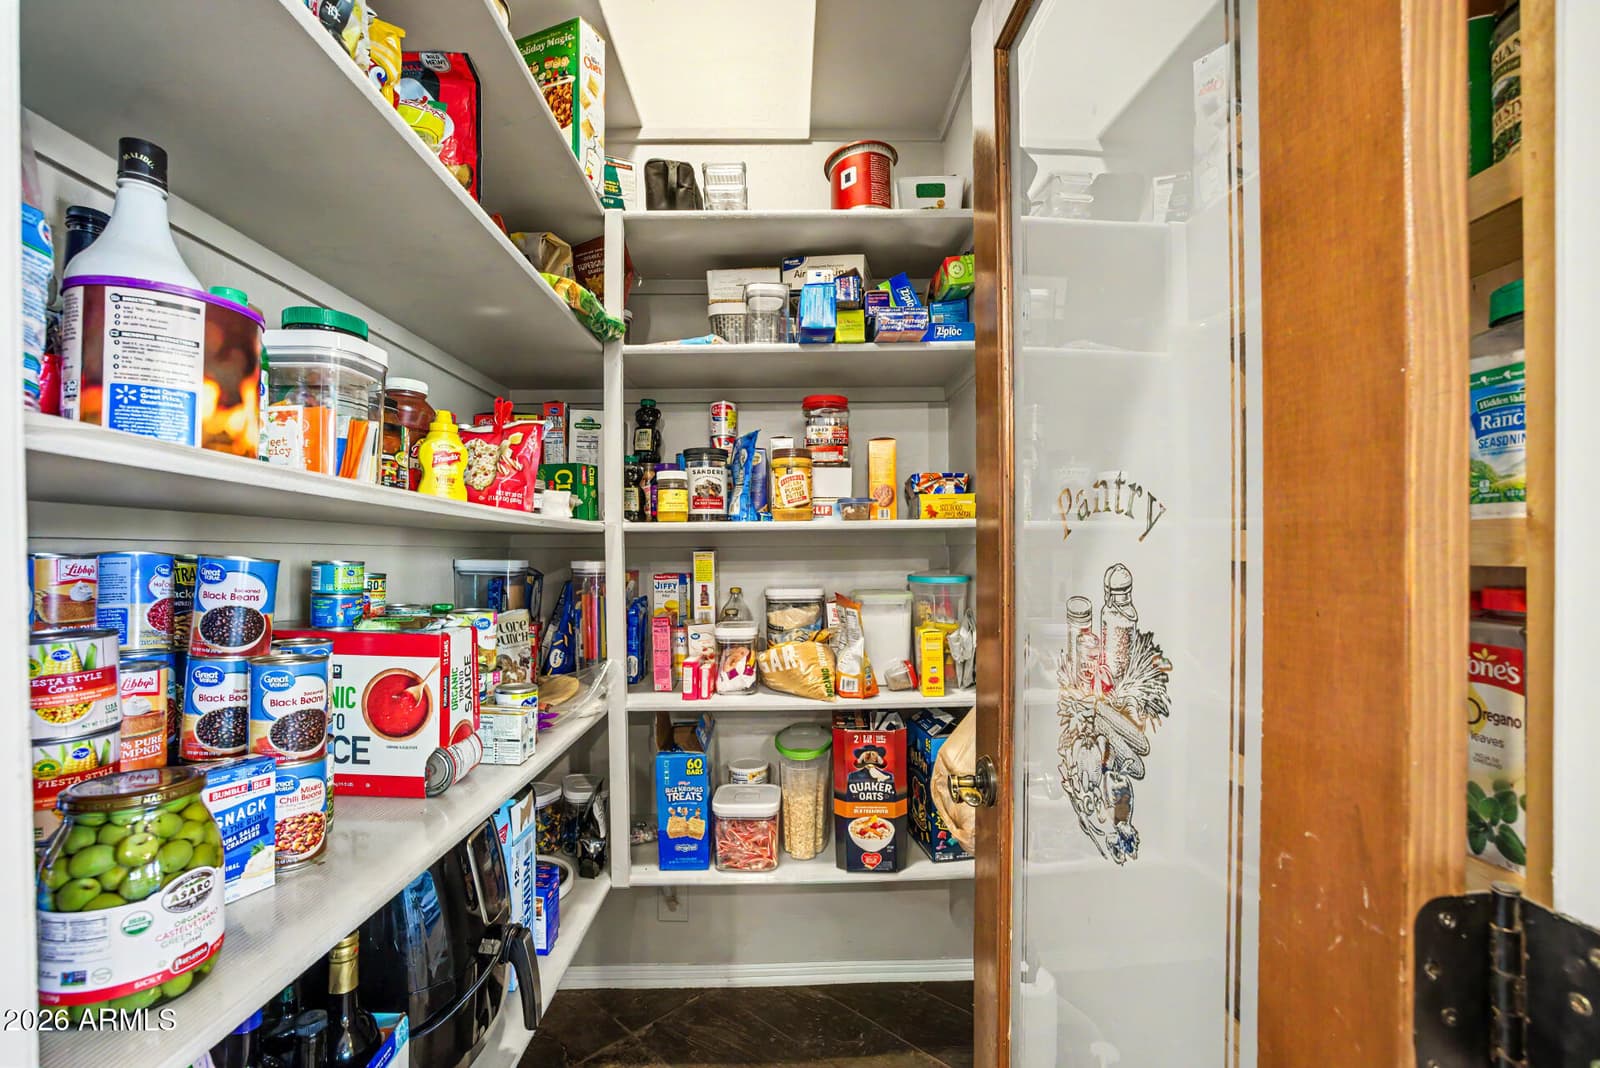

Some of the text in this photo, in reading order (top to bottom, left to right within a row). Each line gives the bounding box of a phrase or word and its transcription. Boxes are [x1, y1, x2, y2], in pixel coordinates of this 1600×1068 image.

[936, 325, 962, 339] Ziploc
[1480, 410, 1526, 430] Ranc
[268, 446, 292, 457] picy
[1058, 470, 1167, 542] Pantry
[64, 562, 95, 578] Libby's
[203, 590, 260, 602] Black Beans
[194, 670, 219, 680] Great
[1468, 658, 1521, 684] one's
[32, 672, 102, 688] ESTA STYLE
[121, 677, 155, 692] Libby's
[264, 675, 289, 684] Great
[464, 654, 472, 713] SAUCE
[451, 667, 459, 711] ORGANIC
[198, 694, 248, 703] Black Bea
[269, 695, 324, 708] Black Beans
[135, 735, 163, 747] PURE
[122, 745, 161, 759] MPKIN
[686, 758, 703, 769] 60
[37, 777, 82, 789] FIESTA
[212, 779, 269, 801] BUMBLE BEE
[276, 780, 294, 788] reat
[849, 782, 892, 794] QUAKER
[666, 792, 703, 802] TREATS
[859, 792, 884, 801] OATS
[239, 824, 260, 839] SALAD
[170, 880, 211, 904] ASARO
[523, 855, 531, 927] EMIUM
